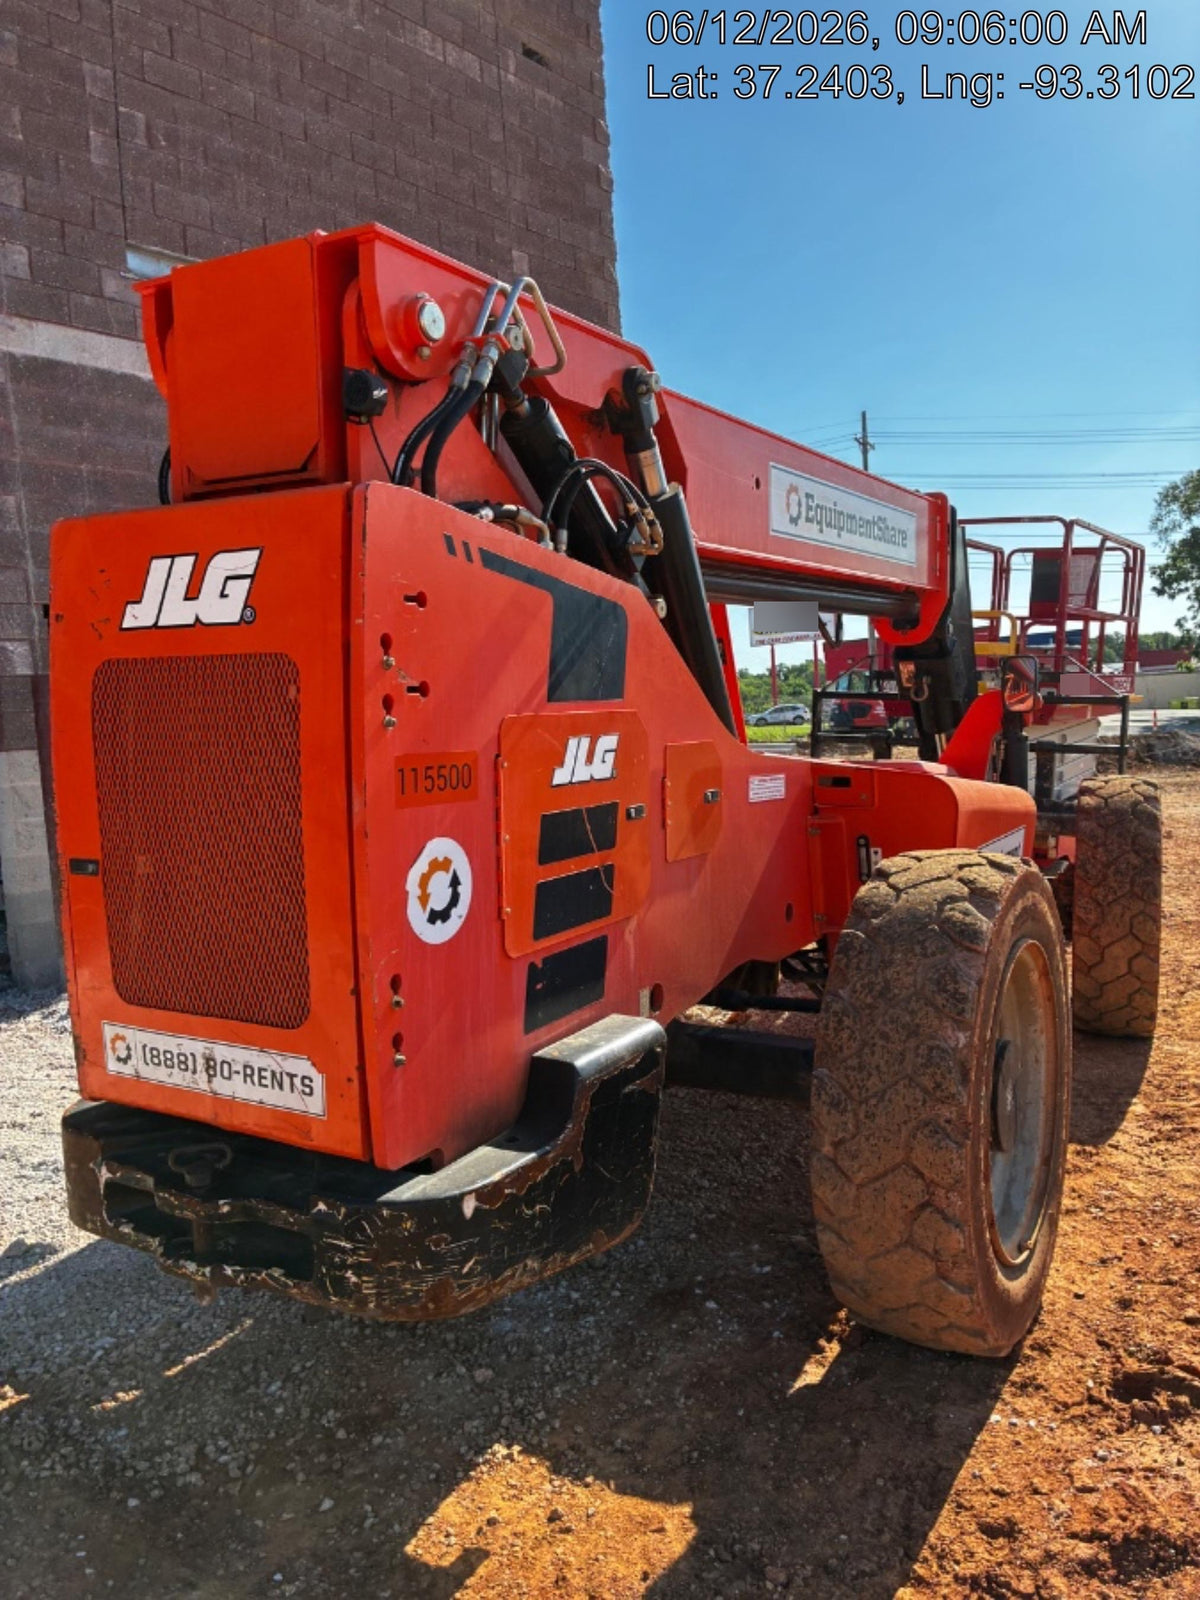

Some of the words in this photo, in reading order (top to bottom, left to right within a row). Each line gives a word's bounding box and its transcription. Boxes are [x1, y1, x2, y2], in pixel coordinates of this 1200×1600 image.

[804, 492, 909, 549] EquipmentShare
[119, 546, 264, 631] JLG
[397, 763, 472, 796] 115500
[551, 733, 619, 787] JLG
[205, 1057, 315, 1098] 80-RENTS
